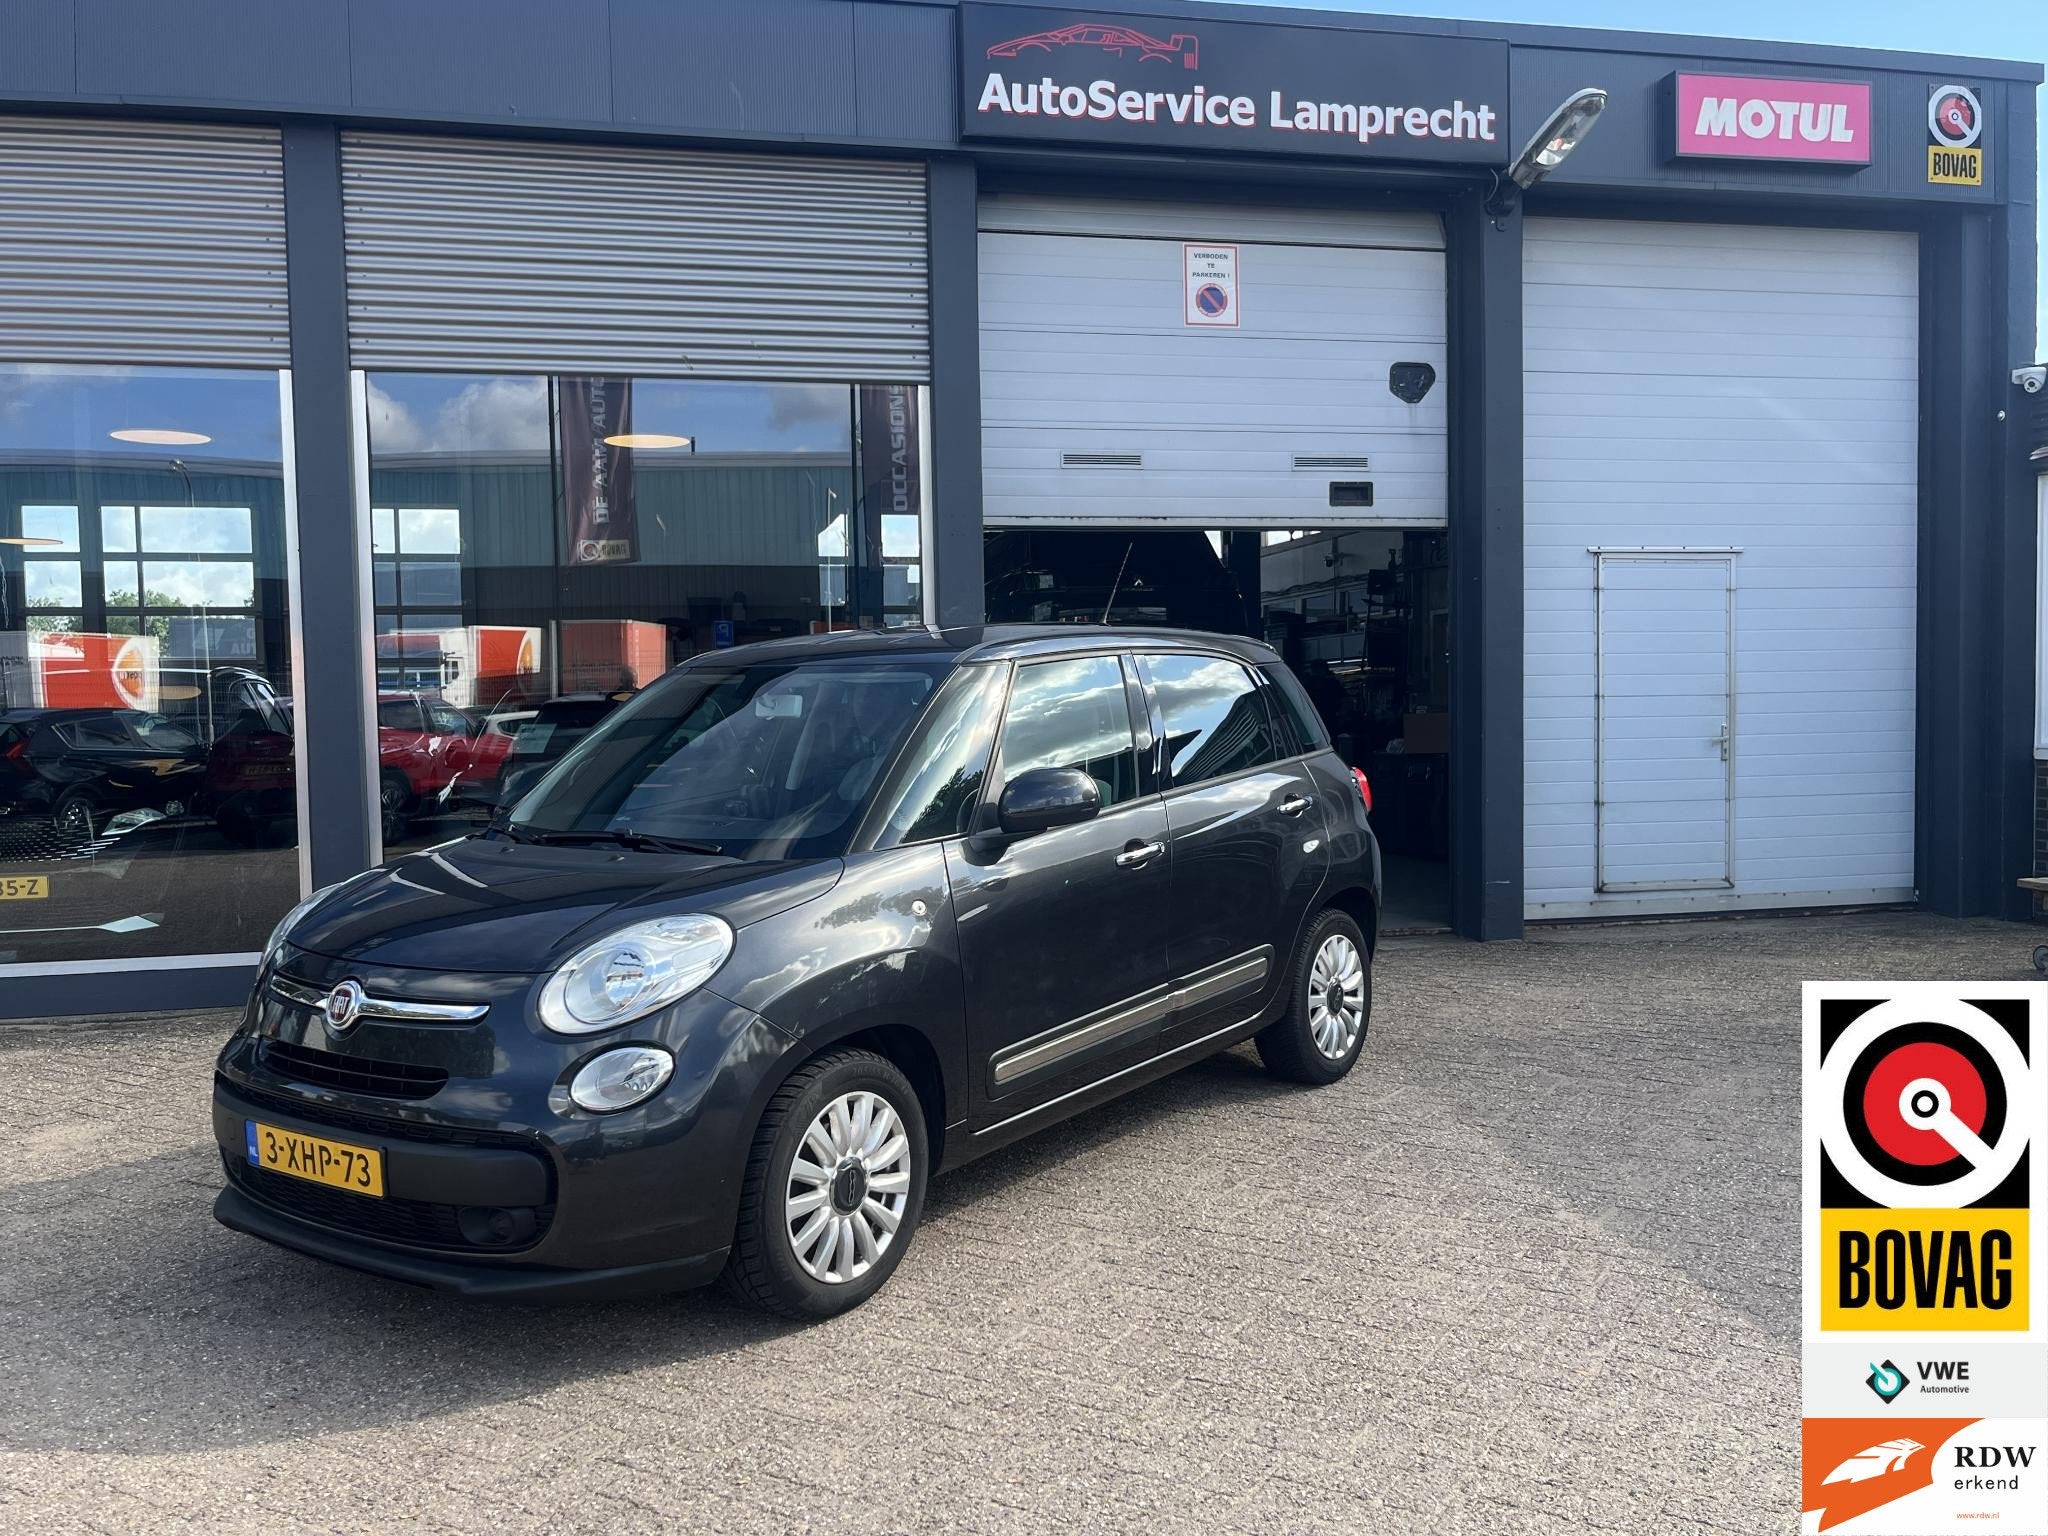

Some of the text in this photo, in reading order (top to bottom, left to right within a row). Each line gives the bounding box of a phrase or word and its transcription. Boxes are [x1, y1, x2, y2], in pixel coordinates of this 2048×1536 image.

[977, 73, 1496, 144] AutoService Lamprecht
[1695, 96, 1854, 143] MOTUL
[1932, 152, 1977, 179] BOVAG
[332, 995, 350, 1014] FIAT
[265, 1131, 371, 1188] 3-XHP-73
